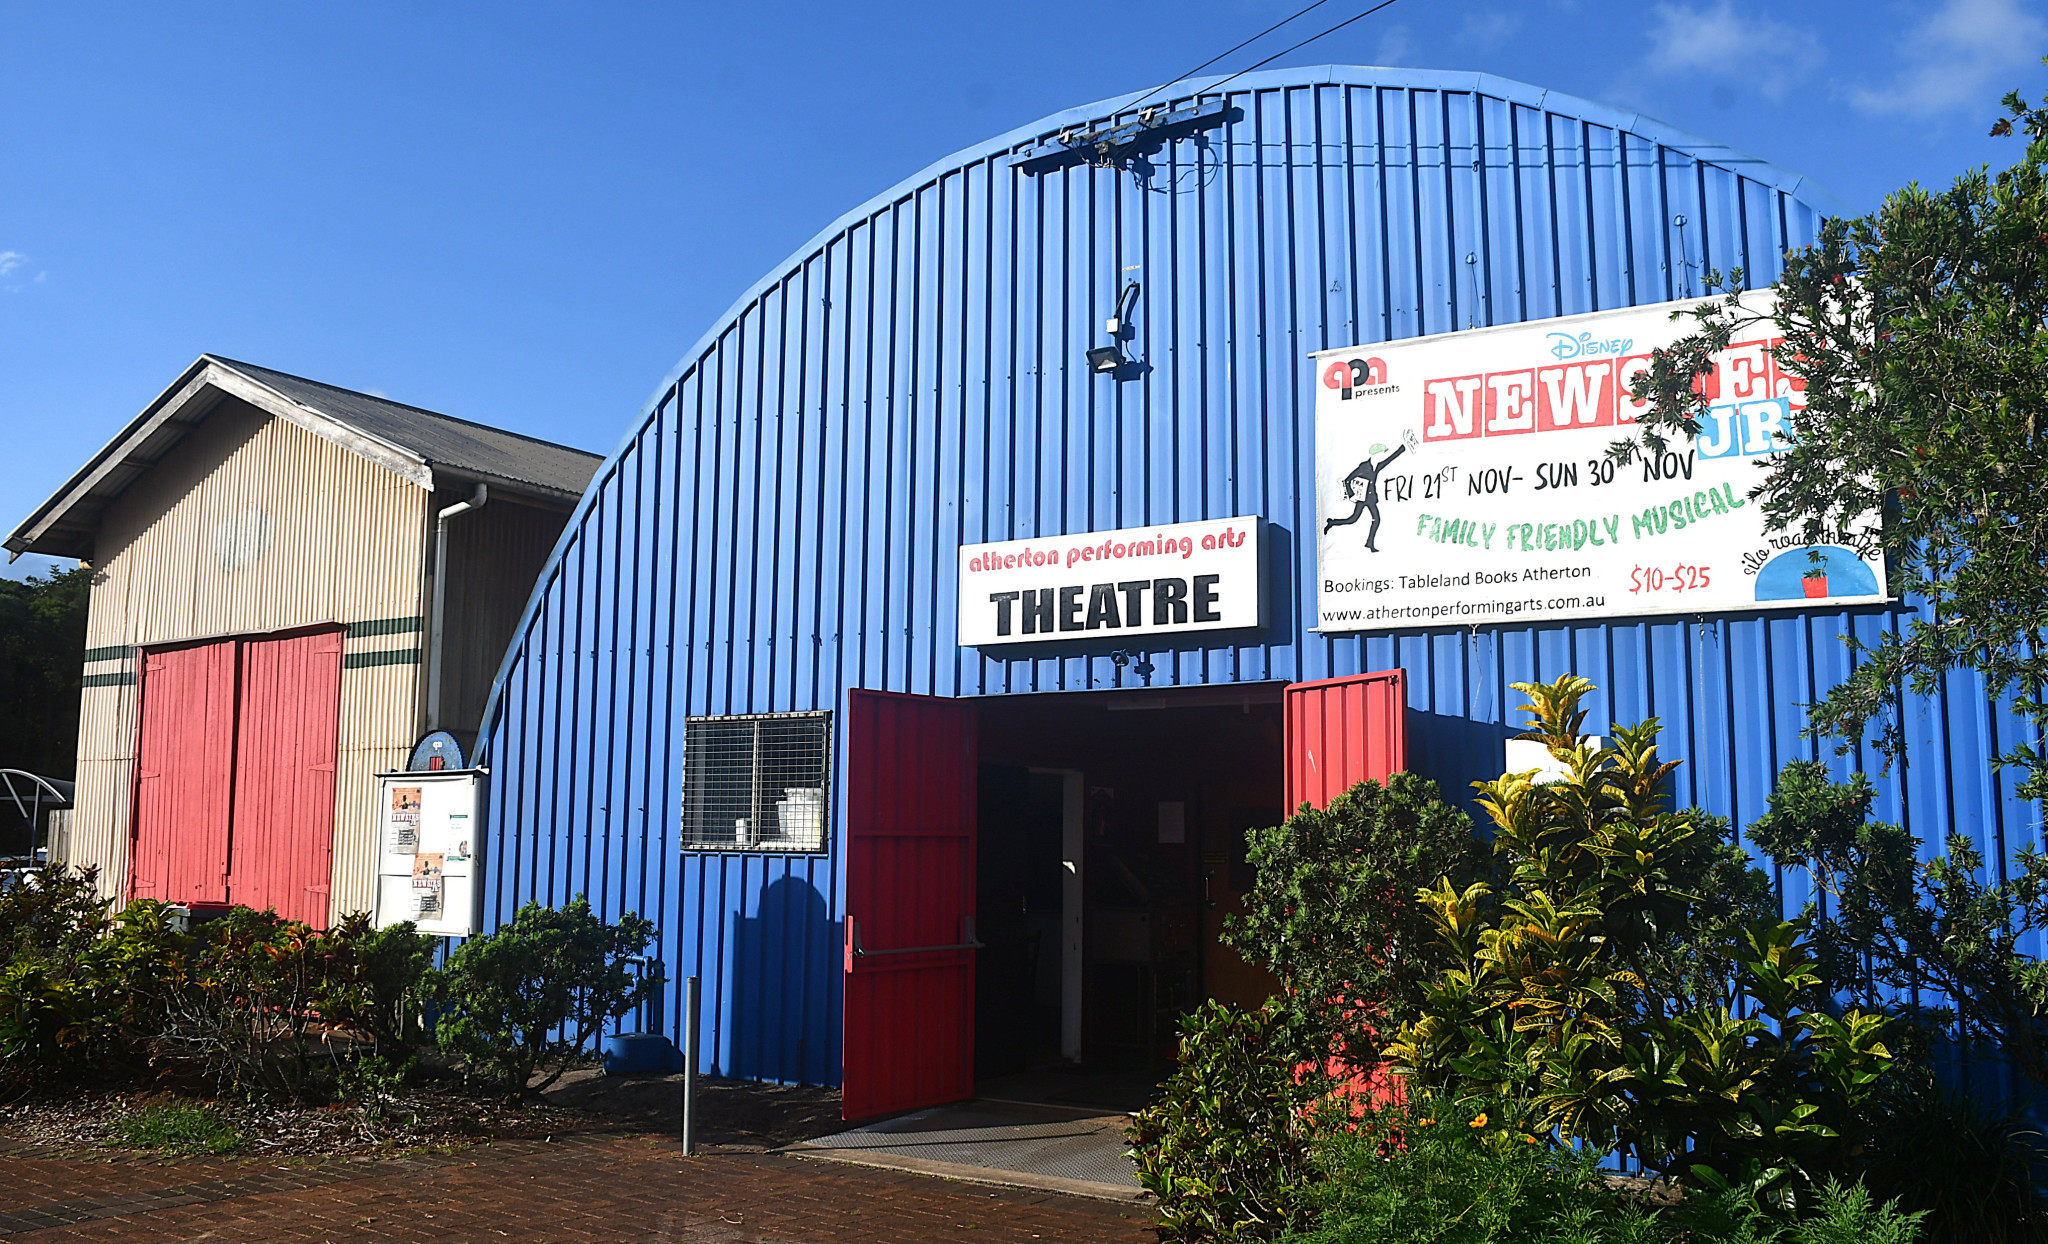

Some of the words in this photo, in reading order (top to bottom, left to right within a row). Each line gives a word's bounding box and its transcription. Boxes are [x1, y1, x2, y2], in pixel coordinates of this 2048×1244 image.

[1355, 384, 1401, 399] presents
[1700, 400, 1793, 457] JR
[1383, 474, 1414, 502] FRI
[1423, 466, 1458, 499] 21ST
[1534, 462, 1578, 490] SUN
[1643, 449, 1695, 483] NOV
[1416, 513, 1497, 550] FAMILY
[1506, 514, 1619, 551] FRIENDLY
[1632, 482, 1746, 540] MUSICAL
[969, 547, 1059, 573] atherton
[1066, 532, 1193, 569] performing
[1201, 526, 1246, 551] arts
[1742, 548, 1770, 576] silo
[1323, 578, 1395, 594] Bookings:
[1399, 571, 1470, 589] Tableland
[1475, 569, 1518, 586] Books
[1522, 565, 1592, 582] Atherton
[1628, 562, 1711, 596] $10-$25
[989, 573, 1222, 637] THEATRE
[1322, 595, 1606, 621] www.athertonperformingarts.com.au
